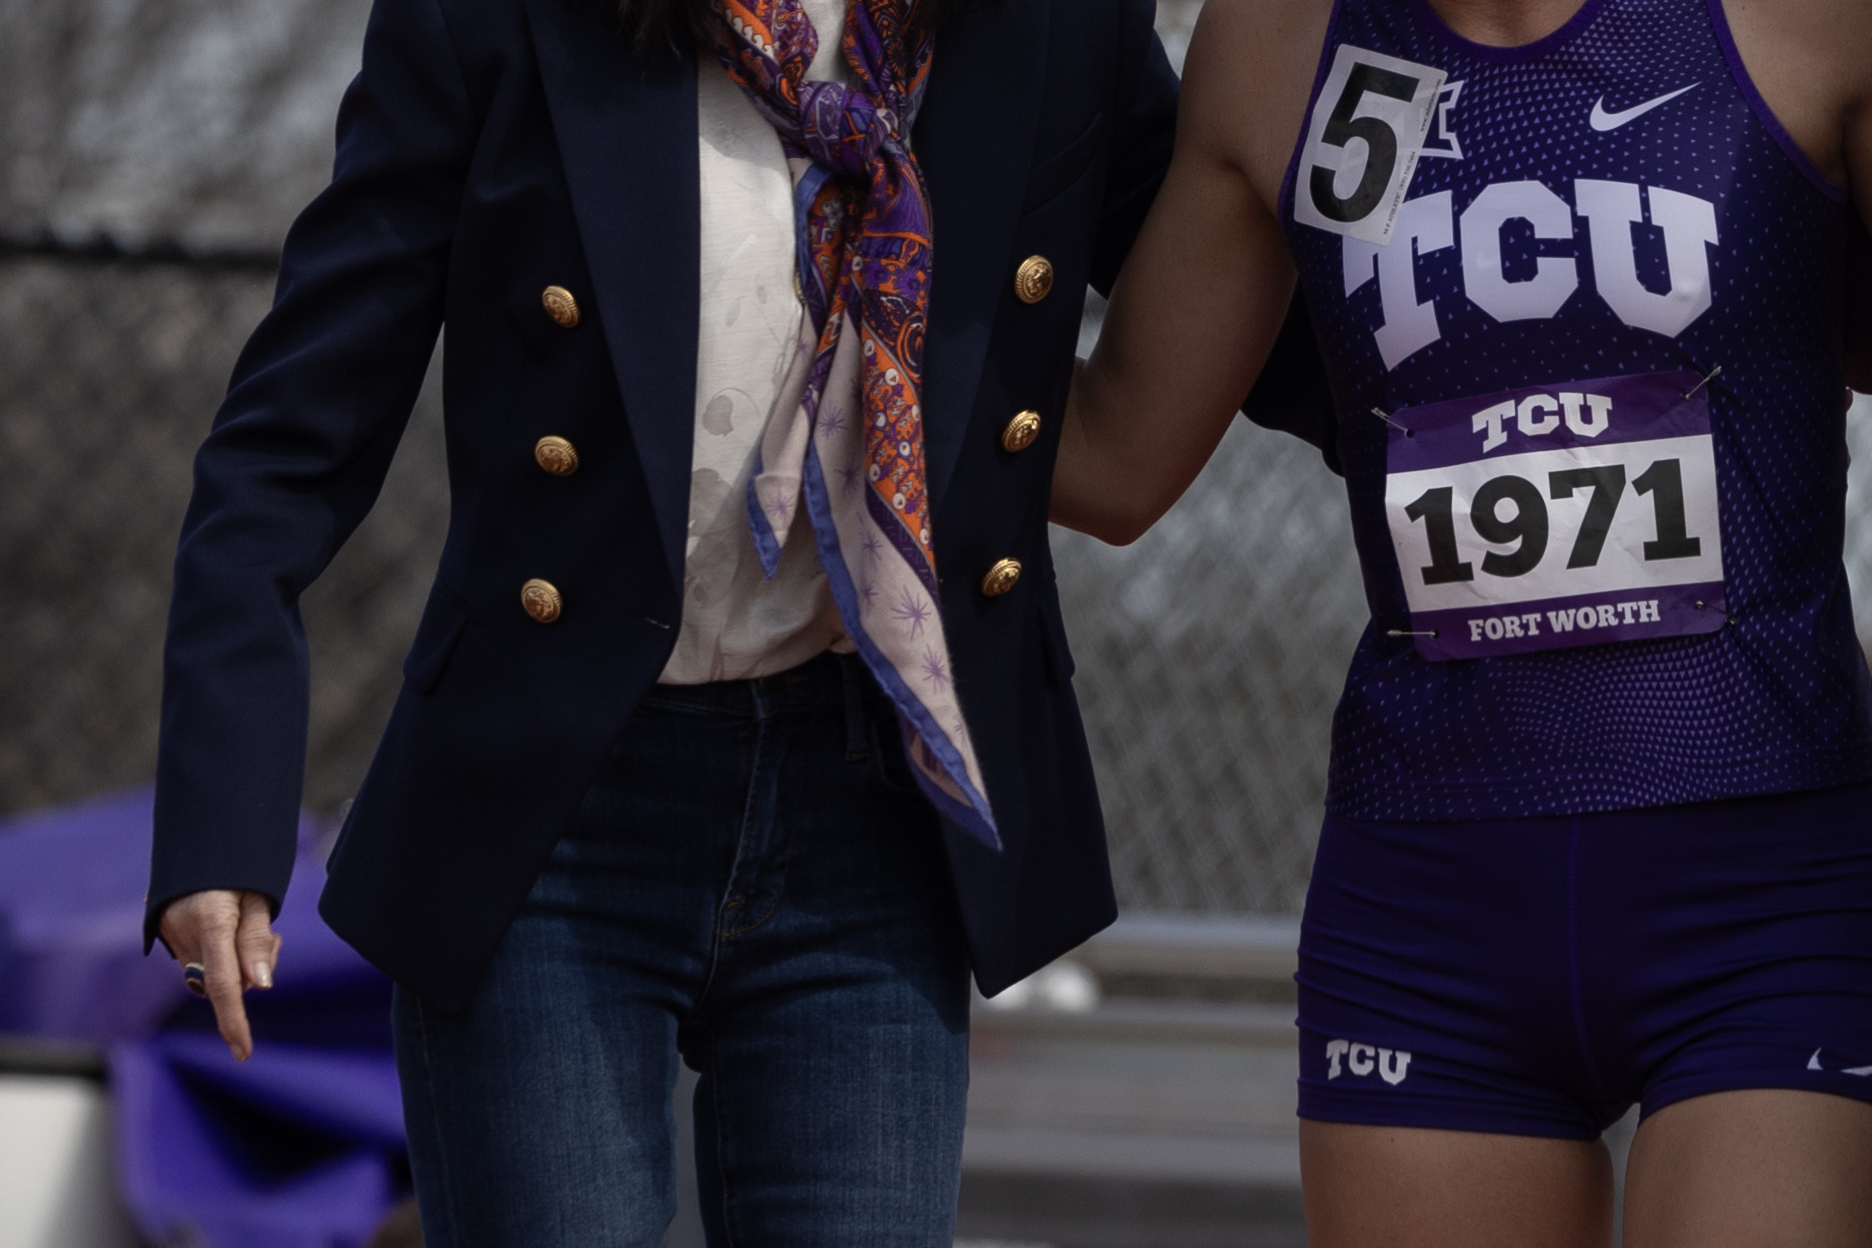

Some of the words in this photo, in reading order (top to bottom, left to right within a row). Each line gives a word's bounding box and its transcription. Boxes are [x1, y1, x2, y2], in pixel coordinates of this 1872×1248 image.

[1309, 62, 1420, 223] 5
[1342, 179, 1719, 372] TCU
[1471, 392, 1613, 453] TCU
[1404, 458, 1702, 586] 1971
[1468, 613, 1542, 642] FORT
[1547, 600, 1661, 633] WORTH
[1326, 1039, 1412, 1086] TCU
